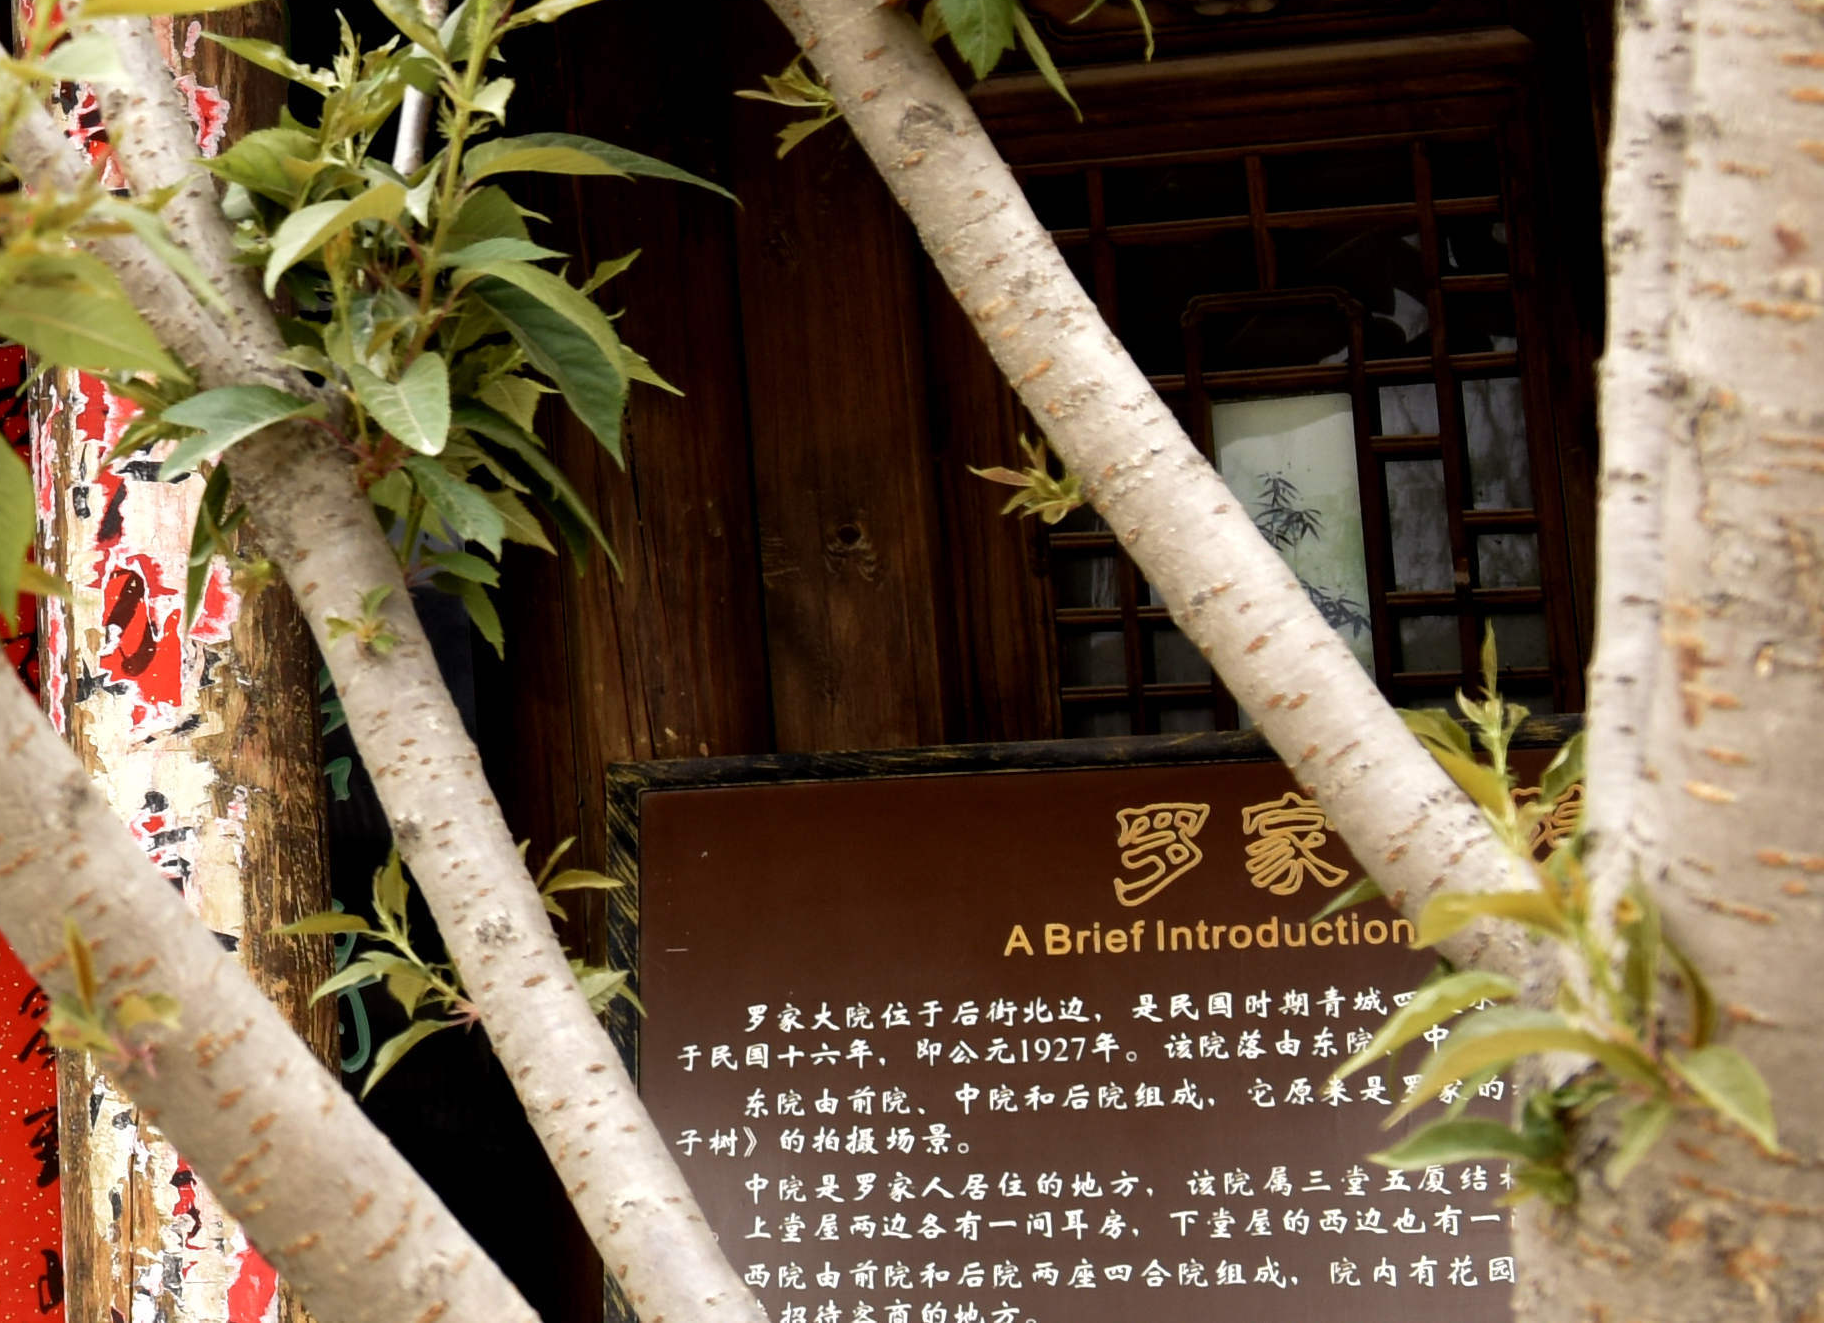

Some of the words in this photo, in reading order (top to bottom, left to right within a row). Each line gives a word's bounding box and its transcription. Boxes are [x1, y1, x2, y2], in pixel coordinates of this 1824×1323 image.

[1005, 925, 1034, 955] A
[1045, 919, 1147, 954] Brief
[1157, 913, 1416, 950] Introduction
